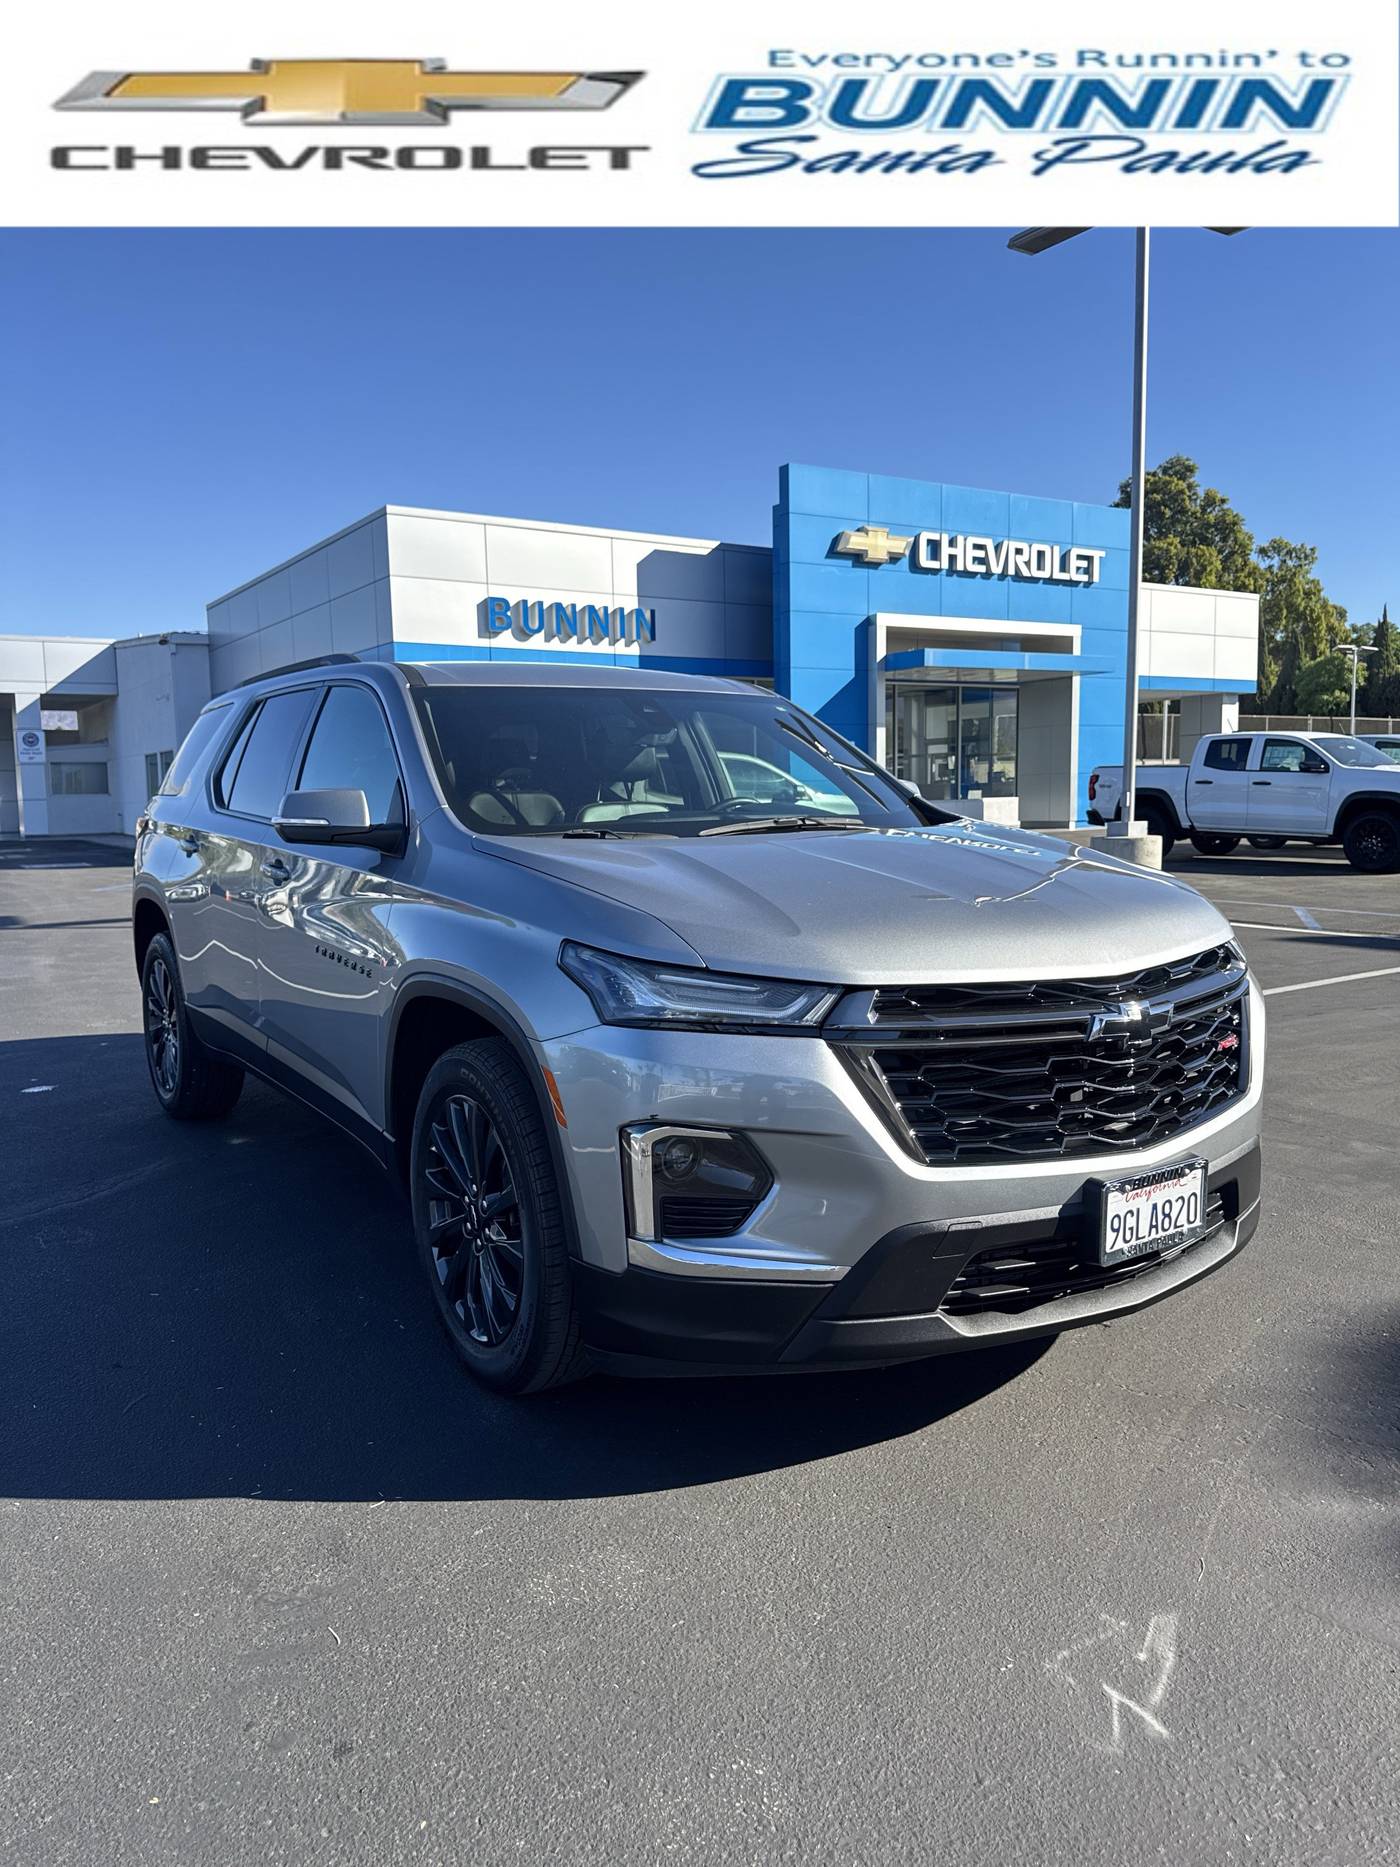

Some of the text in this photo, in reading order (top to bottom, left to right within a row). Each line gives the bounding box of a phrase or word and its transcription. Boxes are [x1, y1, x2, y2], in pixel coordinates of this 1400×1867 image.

[918, 530, 1106, 584] CHEVROLET
[480, 597, 656, 645] BUNNIN
[1110, 1191, 1198, 1250] 9GLA820
